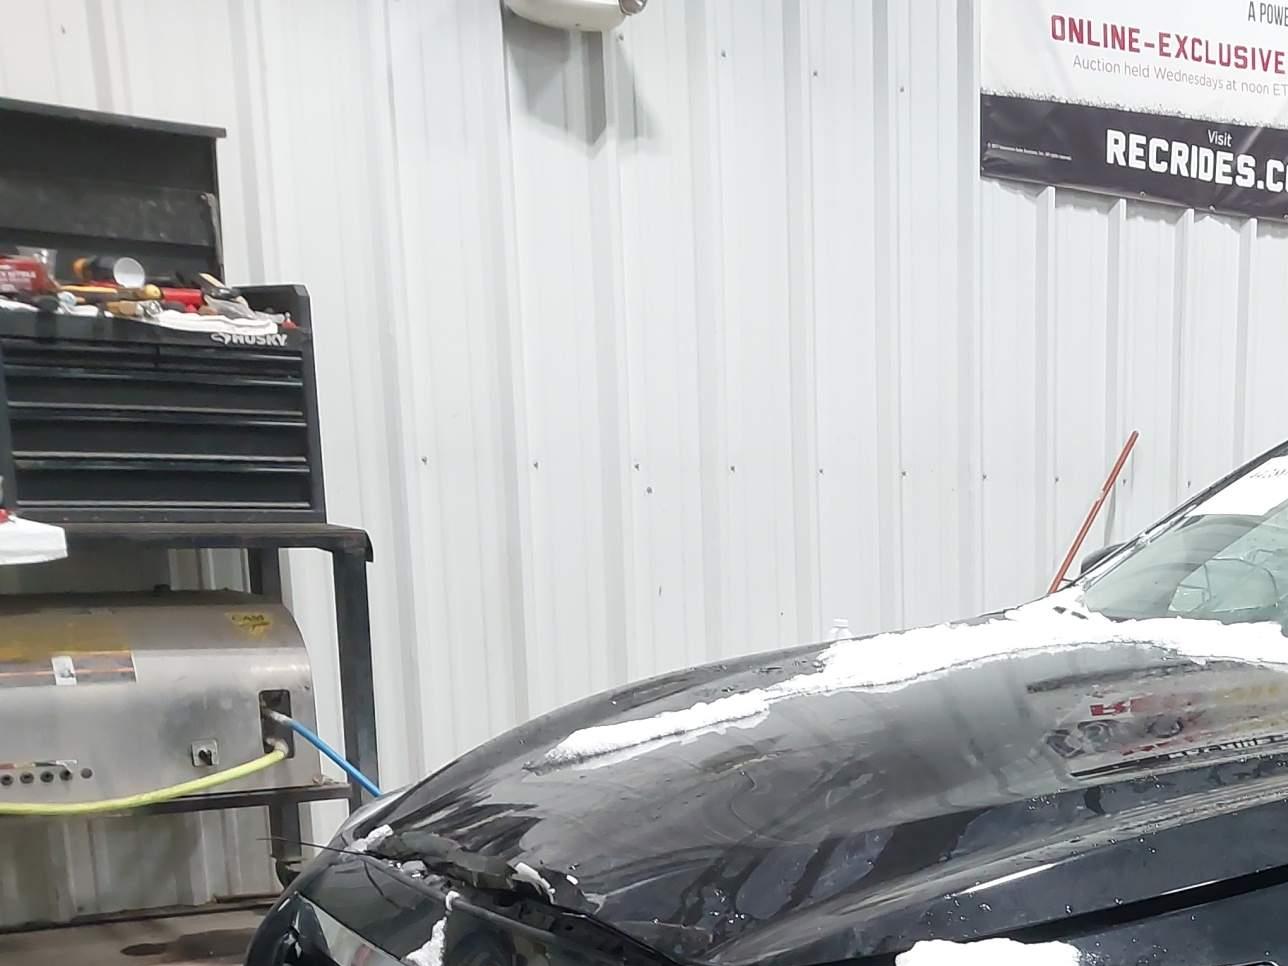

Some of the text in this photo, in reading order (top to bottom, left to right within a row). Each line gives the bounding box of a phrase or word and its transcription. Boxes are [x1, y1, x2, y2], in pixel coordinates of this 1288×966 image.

[1248, 2, 1256, 22] A
[1051, 14, 1285, 74] ONLINE-EXCLUSIVE
[1073, 55, 1121, 73] Auction
[1124, 62, 1149, 78] held
[1153, 66, 1224, 90] Wednesdays
[1226, 79, 1237, 91] at
[1241, 81, 1269, 96] noon
[1274, 83, 1288, 97] ET
[1207, 129, 1232, 147] Visit
[232, 334, 287, 346] HUSKY
